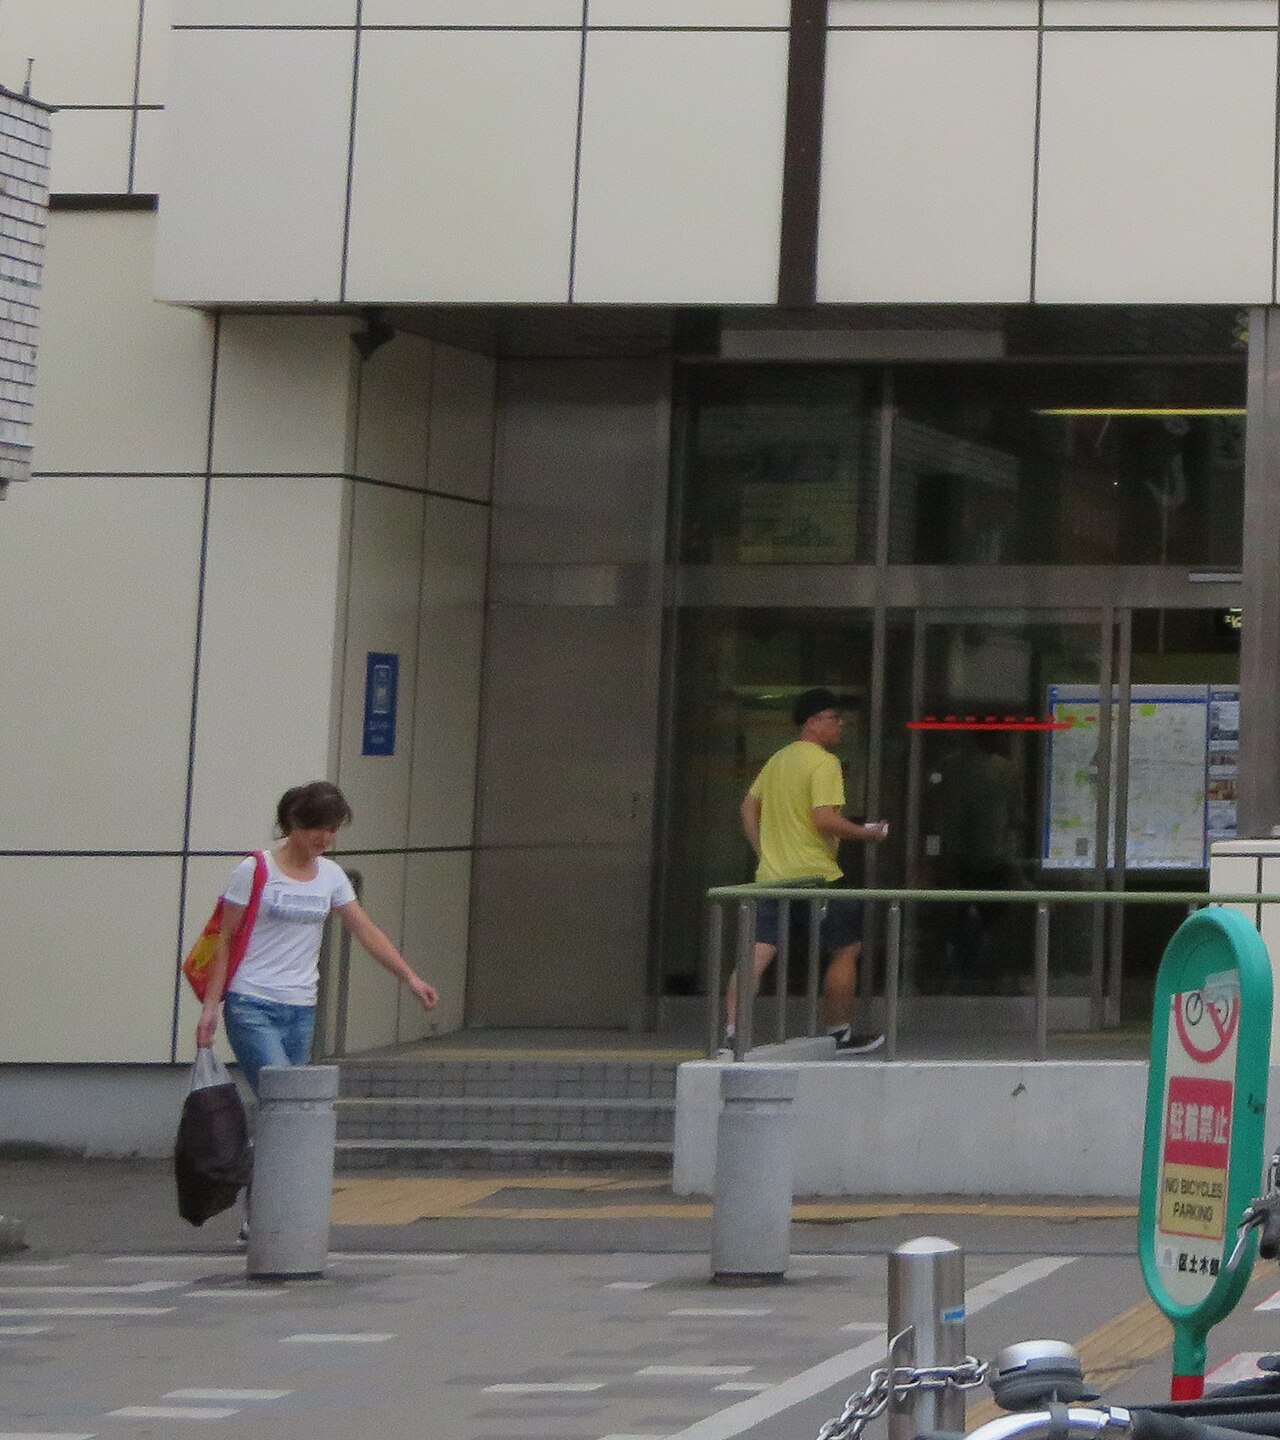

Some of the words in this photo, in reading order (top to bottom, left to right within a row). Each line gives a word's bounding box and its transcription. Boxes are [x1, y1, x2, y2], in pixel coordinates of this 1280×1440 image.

[1165, 1177, 1180, 1194] NO
[1181, 1179, 1222, 1199] BICYCLES
[1172, 1201, 1214, 1223] PARKING
